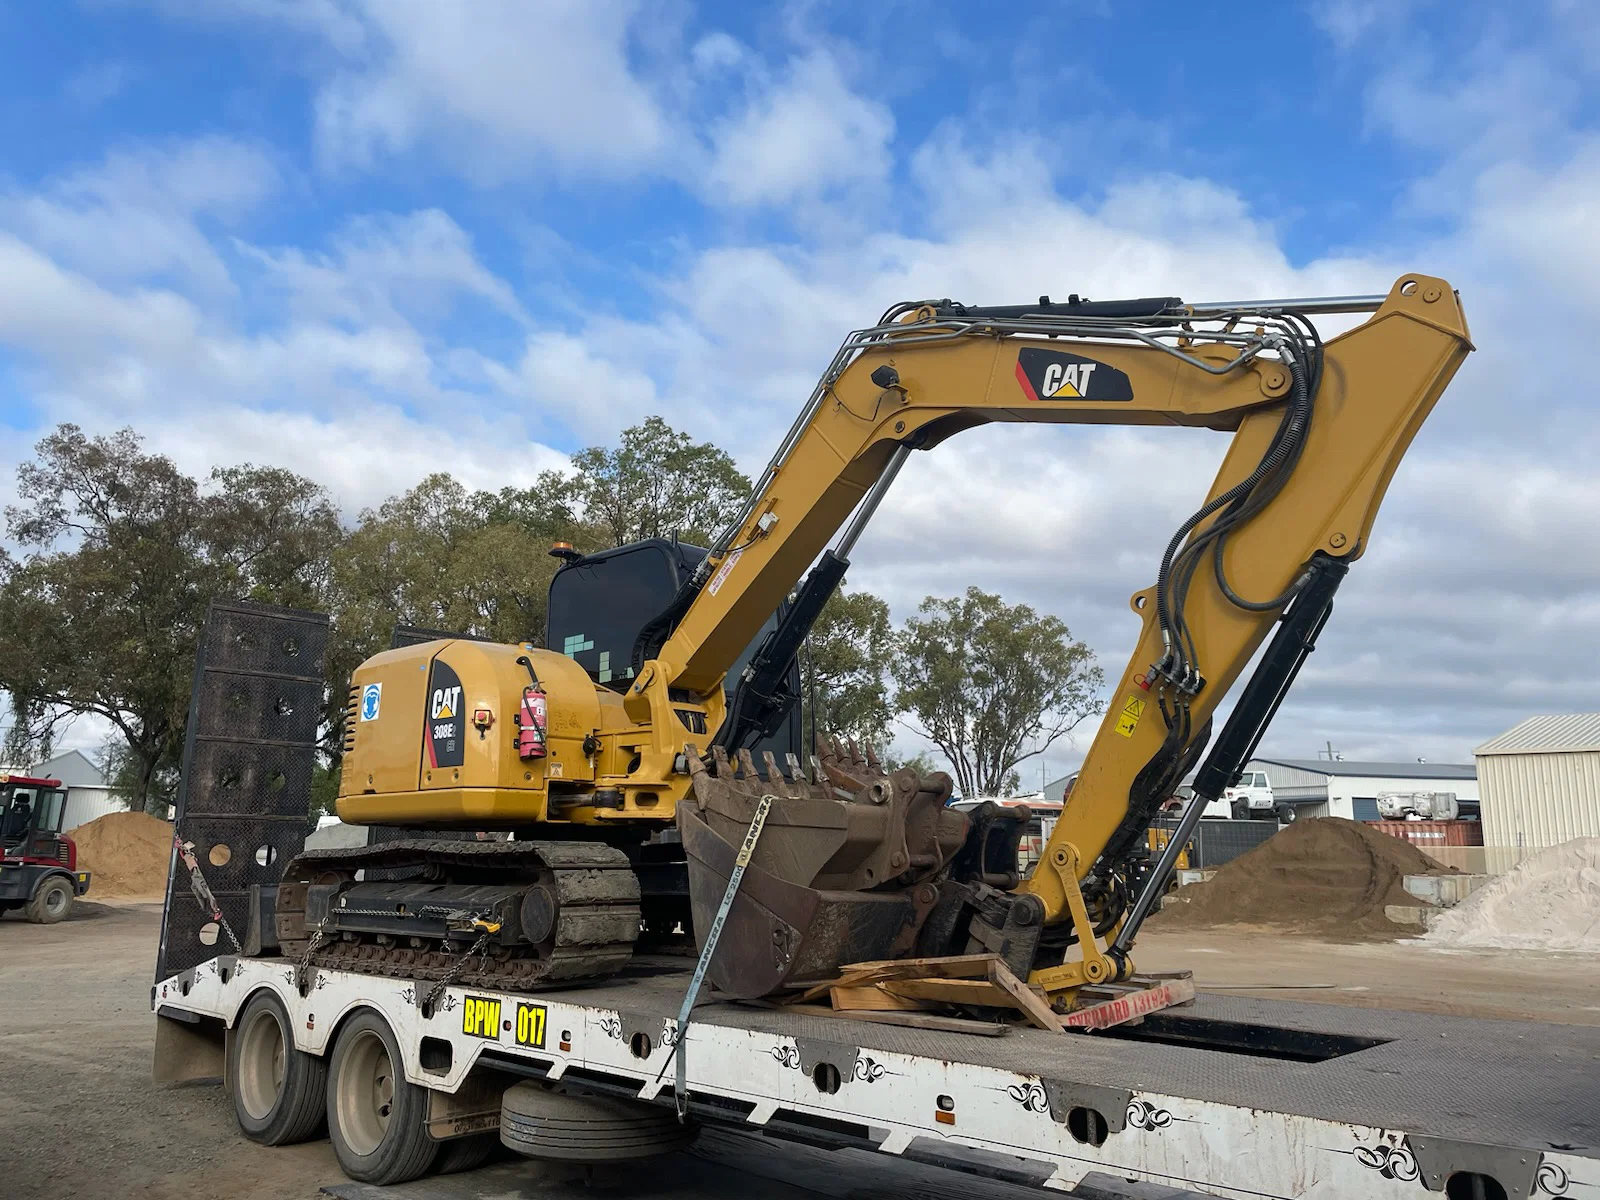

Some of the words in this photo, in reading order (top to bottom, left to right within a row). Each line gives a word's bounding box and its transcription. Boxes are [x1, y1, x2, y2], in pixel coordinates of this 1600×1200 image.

[1042, 363, 1097, 398] CAT
[431, 685, 462, 720] CAT
[700, 916, 724, 973] ANCRA
[463, 998, 501, 1038] BPW
[517, 1005, 546, 1046] 017
